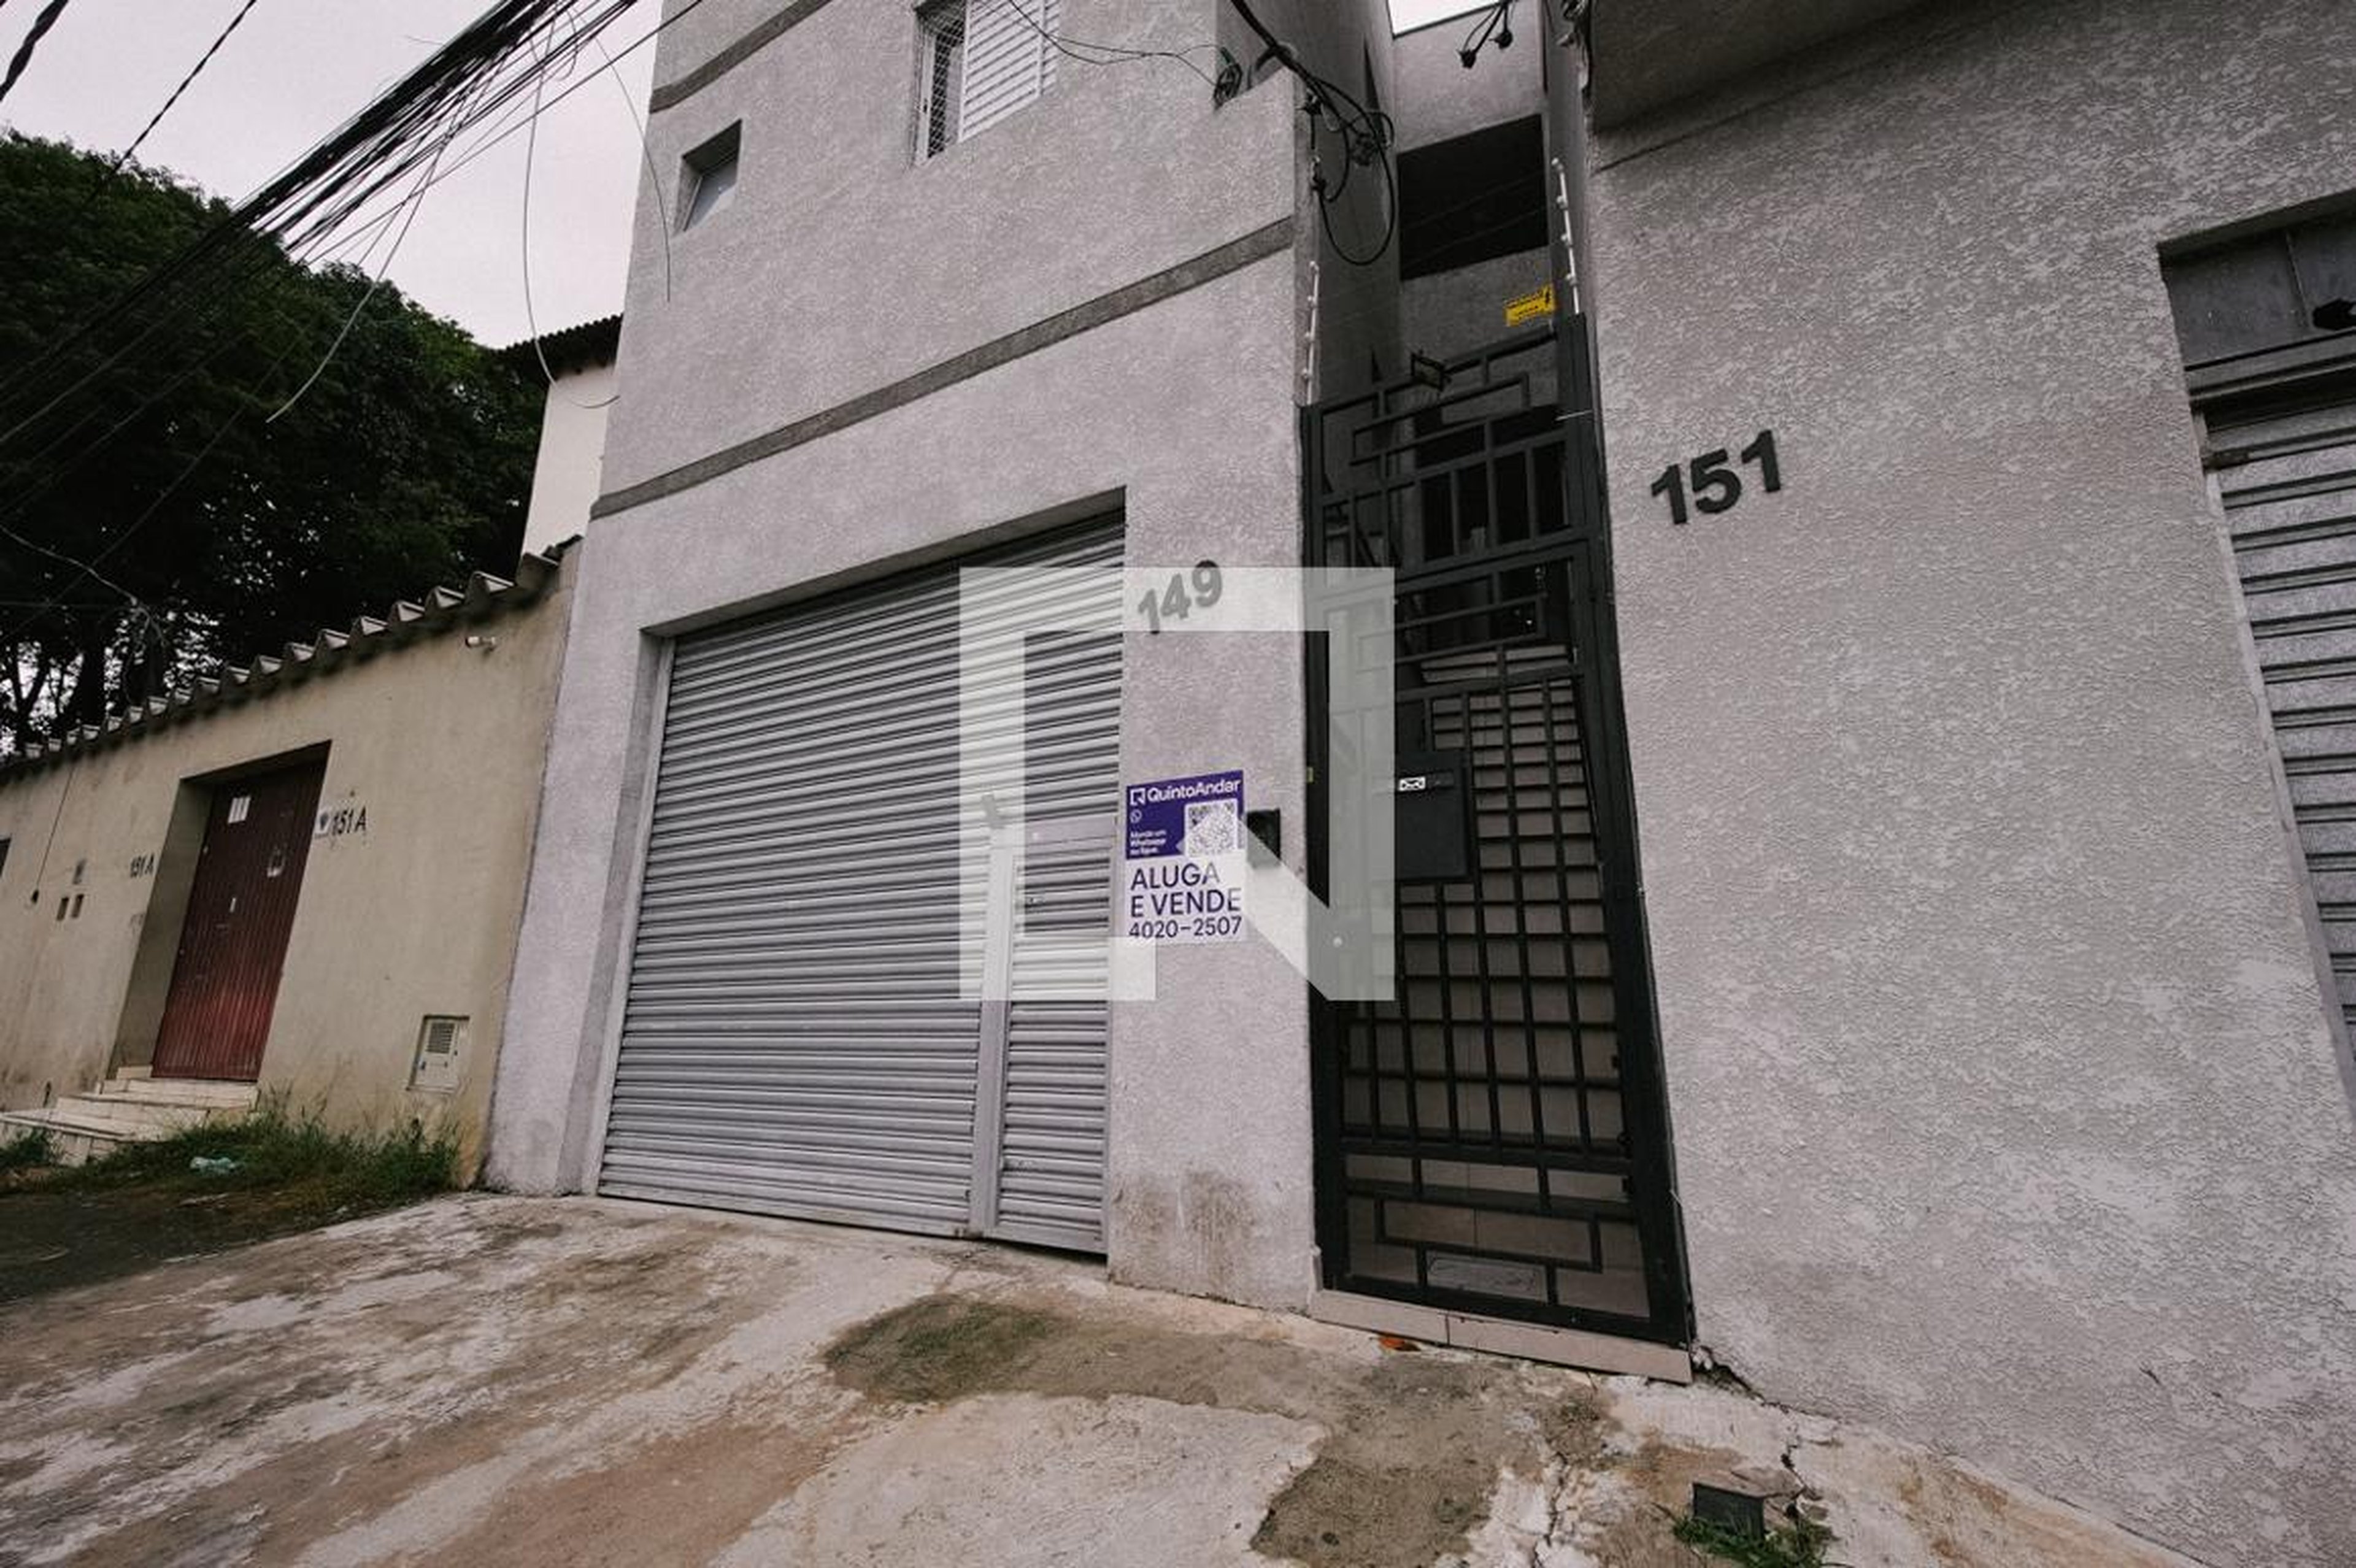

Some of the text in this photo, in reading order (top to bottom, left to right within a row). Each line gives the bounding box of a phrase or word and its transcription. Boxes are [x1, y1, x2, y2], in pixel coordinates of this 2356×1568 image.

[1650, 429, 1781, 526] 151
[1138, 559, 1223, 635] 149
[1147, 778, 1241, 803] QuintoAndar
[1130, 861, 1220, 891] ALUGA
[1131, 888, 1241, 918] E VENDE
[1129, 916, 1242, 939] 4020-2507
